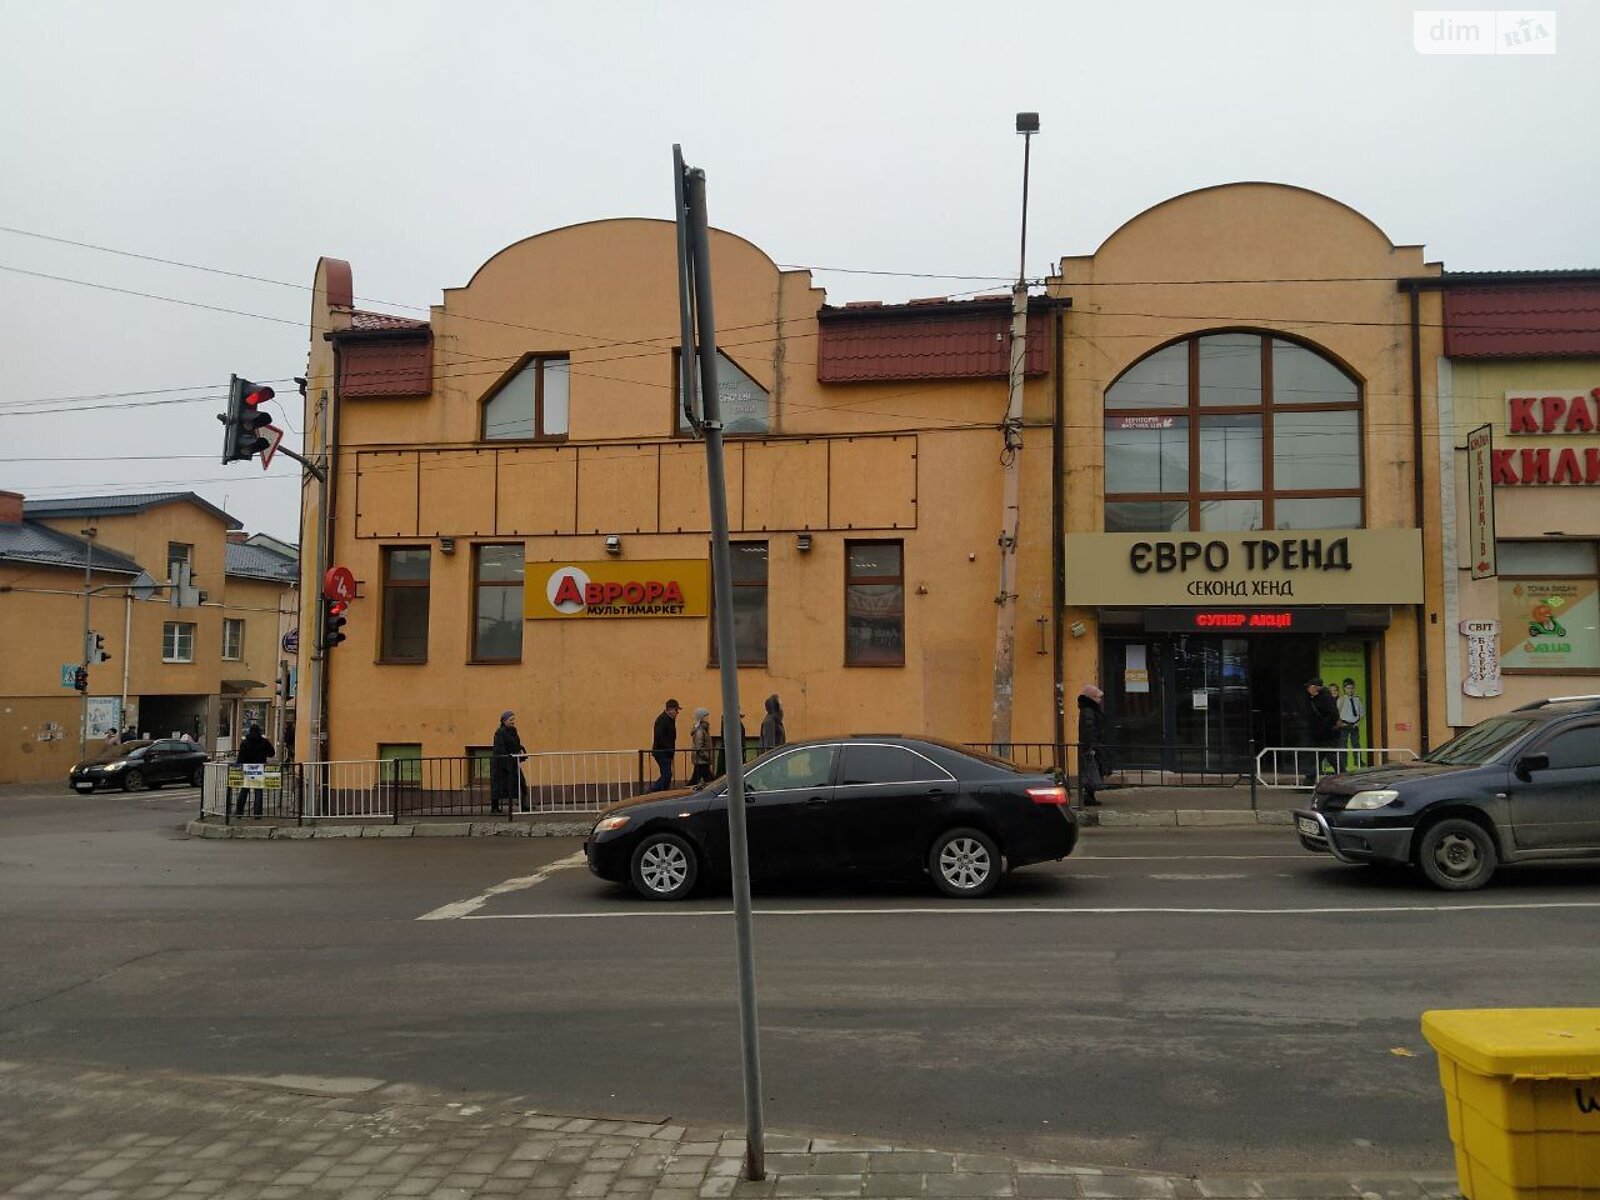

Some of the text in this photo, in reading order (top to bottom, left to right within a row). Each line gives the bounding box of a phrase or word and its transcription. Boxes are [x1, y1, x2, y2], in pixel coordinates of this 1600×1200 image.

[1129, 536, 1352, 574] ЄВРО ТРЕНД
[554, 575, 684, 606] АВРОРА
[1186, 580, 1294, 597] СЕКОНД ХЕНД
[586, 604, 685, 614] МУЛЬТИМАРКЕТ
[1196, 613, 1246, 627] СУПЕР
[1468, 623, 1493, 632] СВІТ
